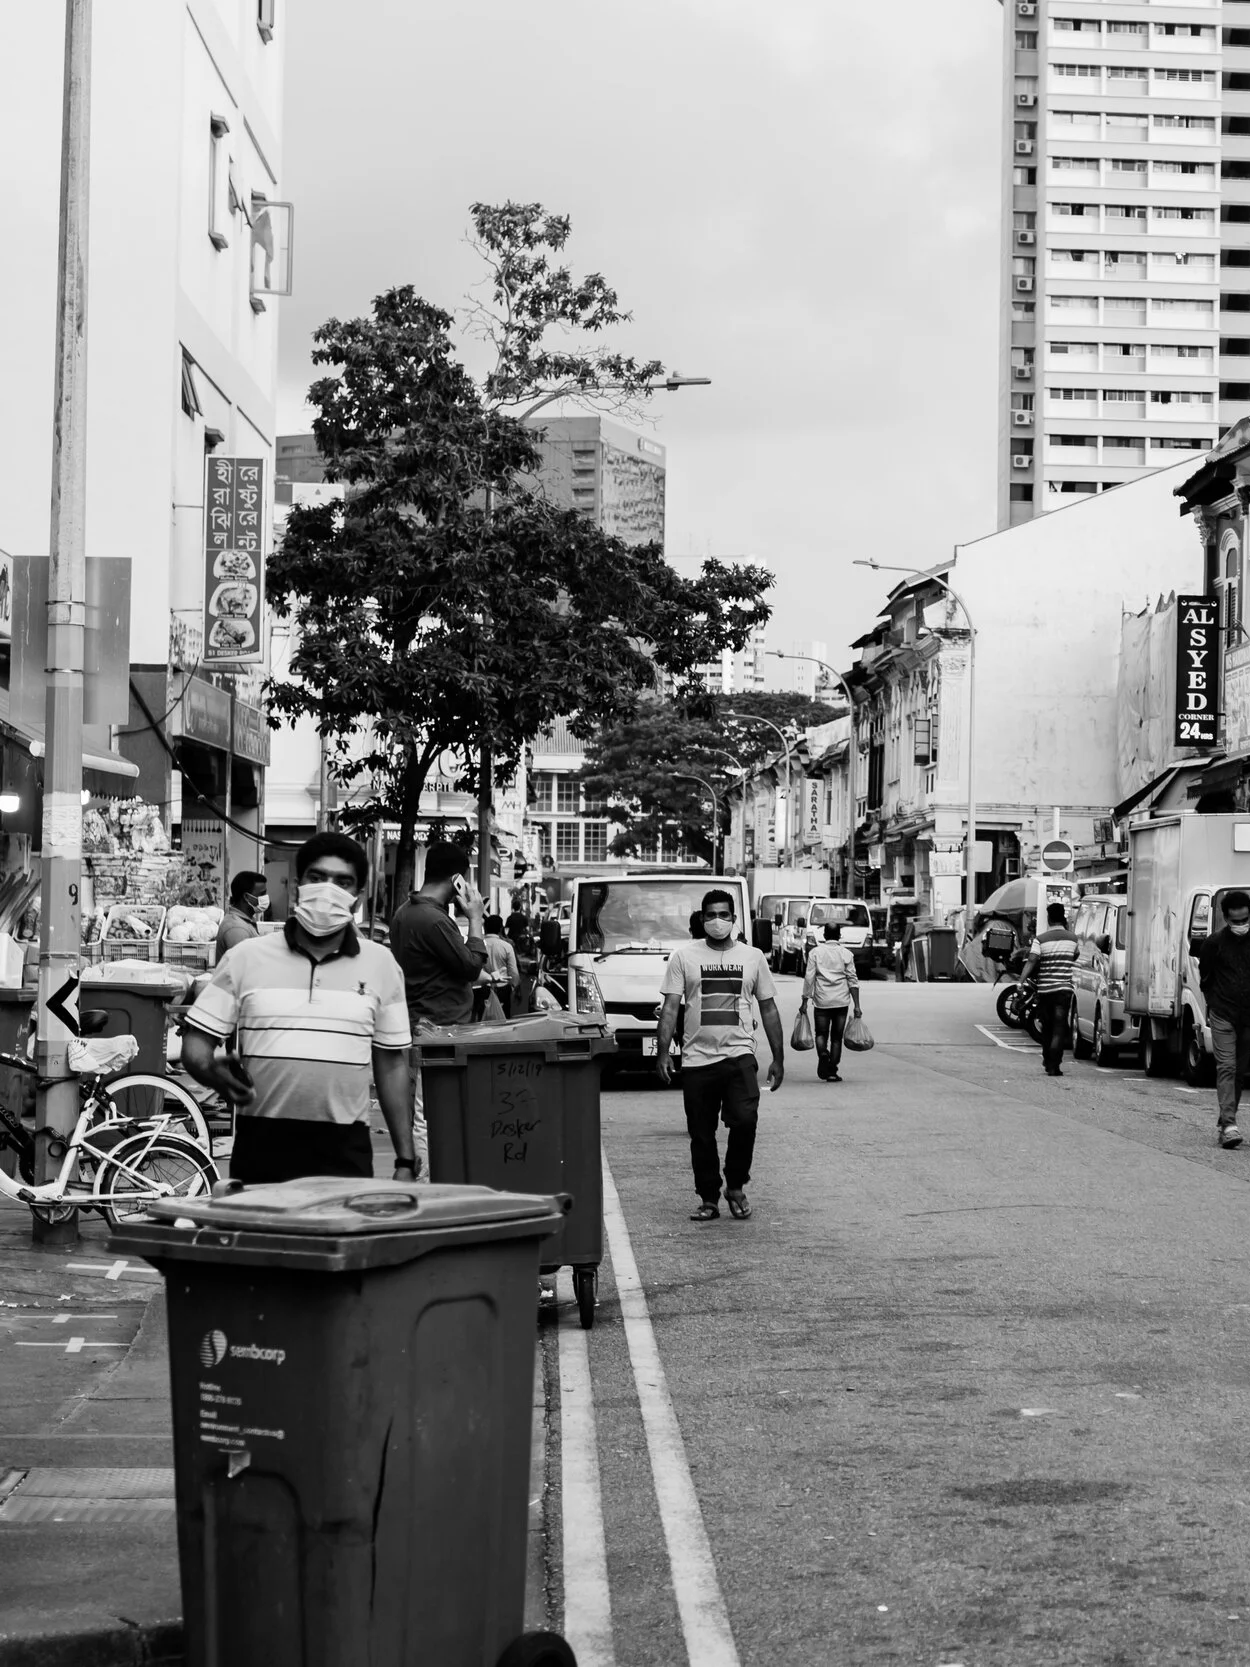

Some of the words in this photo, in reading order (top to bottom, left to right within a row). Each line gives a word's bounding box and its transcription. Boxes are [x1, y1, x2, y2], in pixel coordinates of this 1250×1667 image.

[1182, 608, 1214, 625] AL
[1186, 628, 1208, 711] SYED
[1178, 713, 1214, 721] CORNER
[504, 1142, 527, 1163] Rd
[229, 1343, 286, 1366] sembcorp
